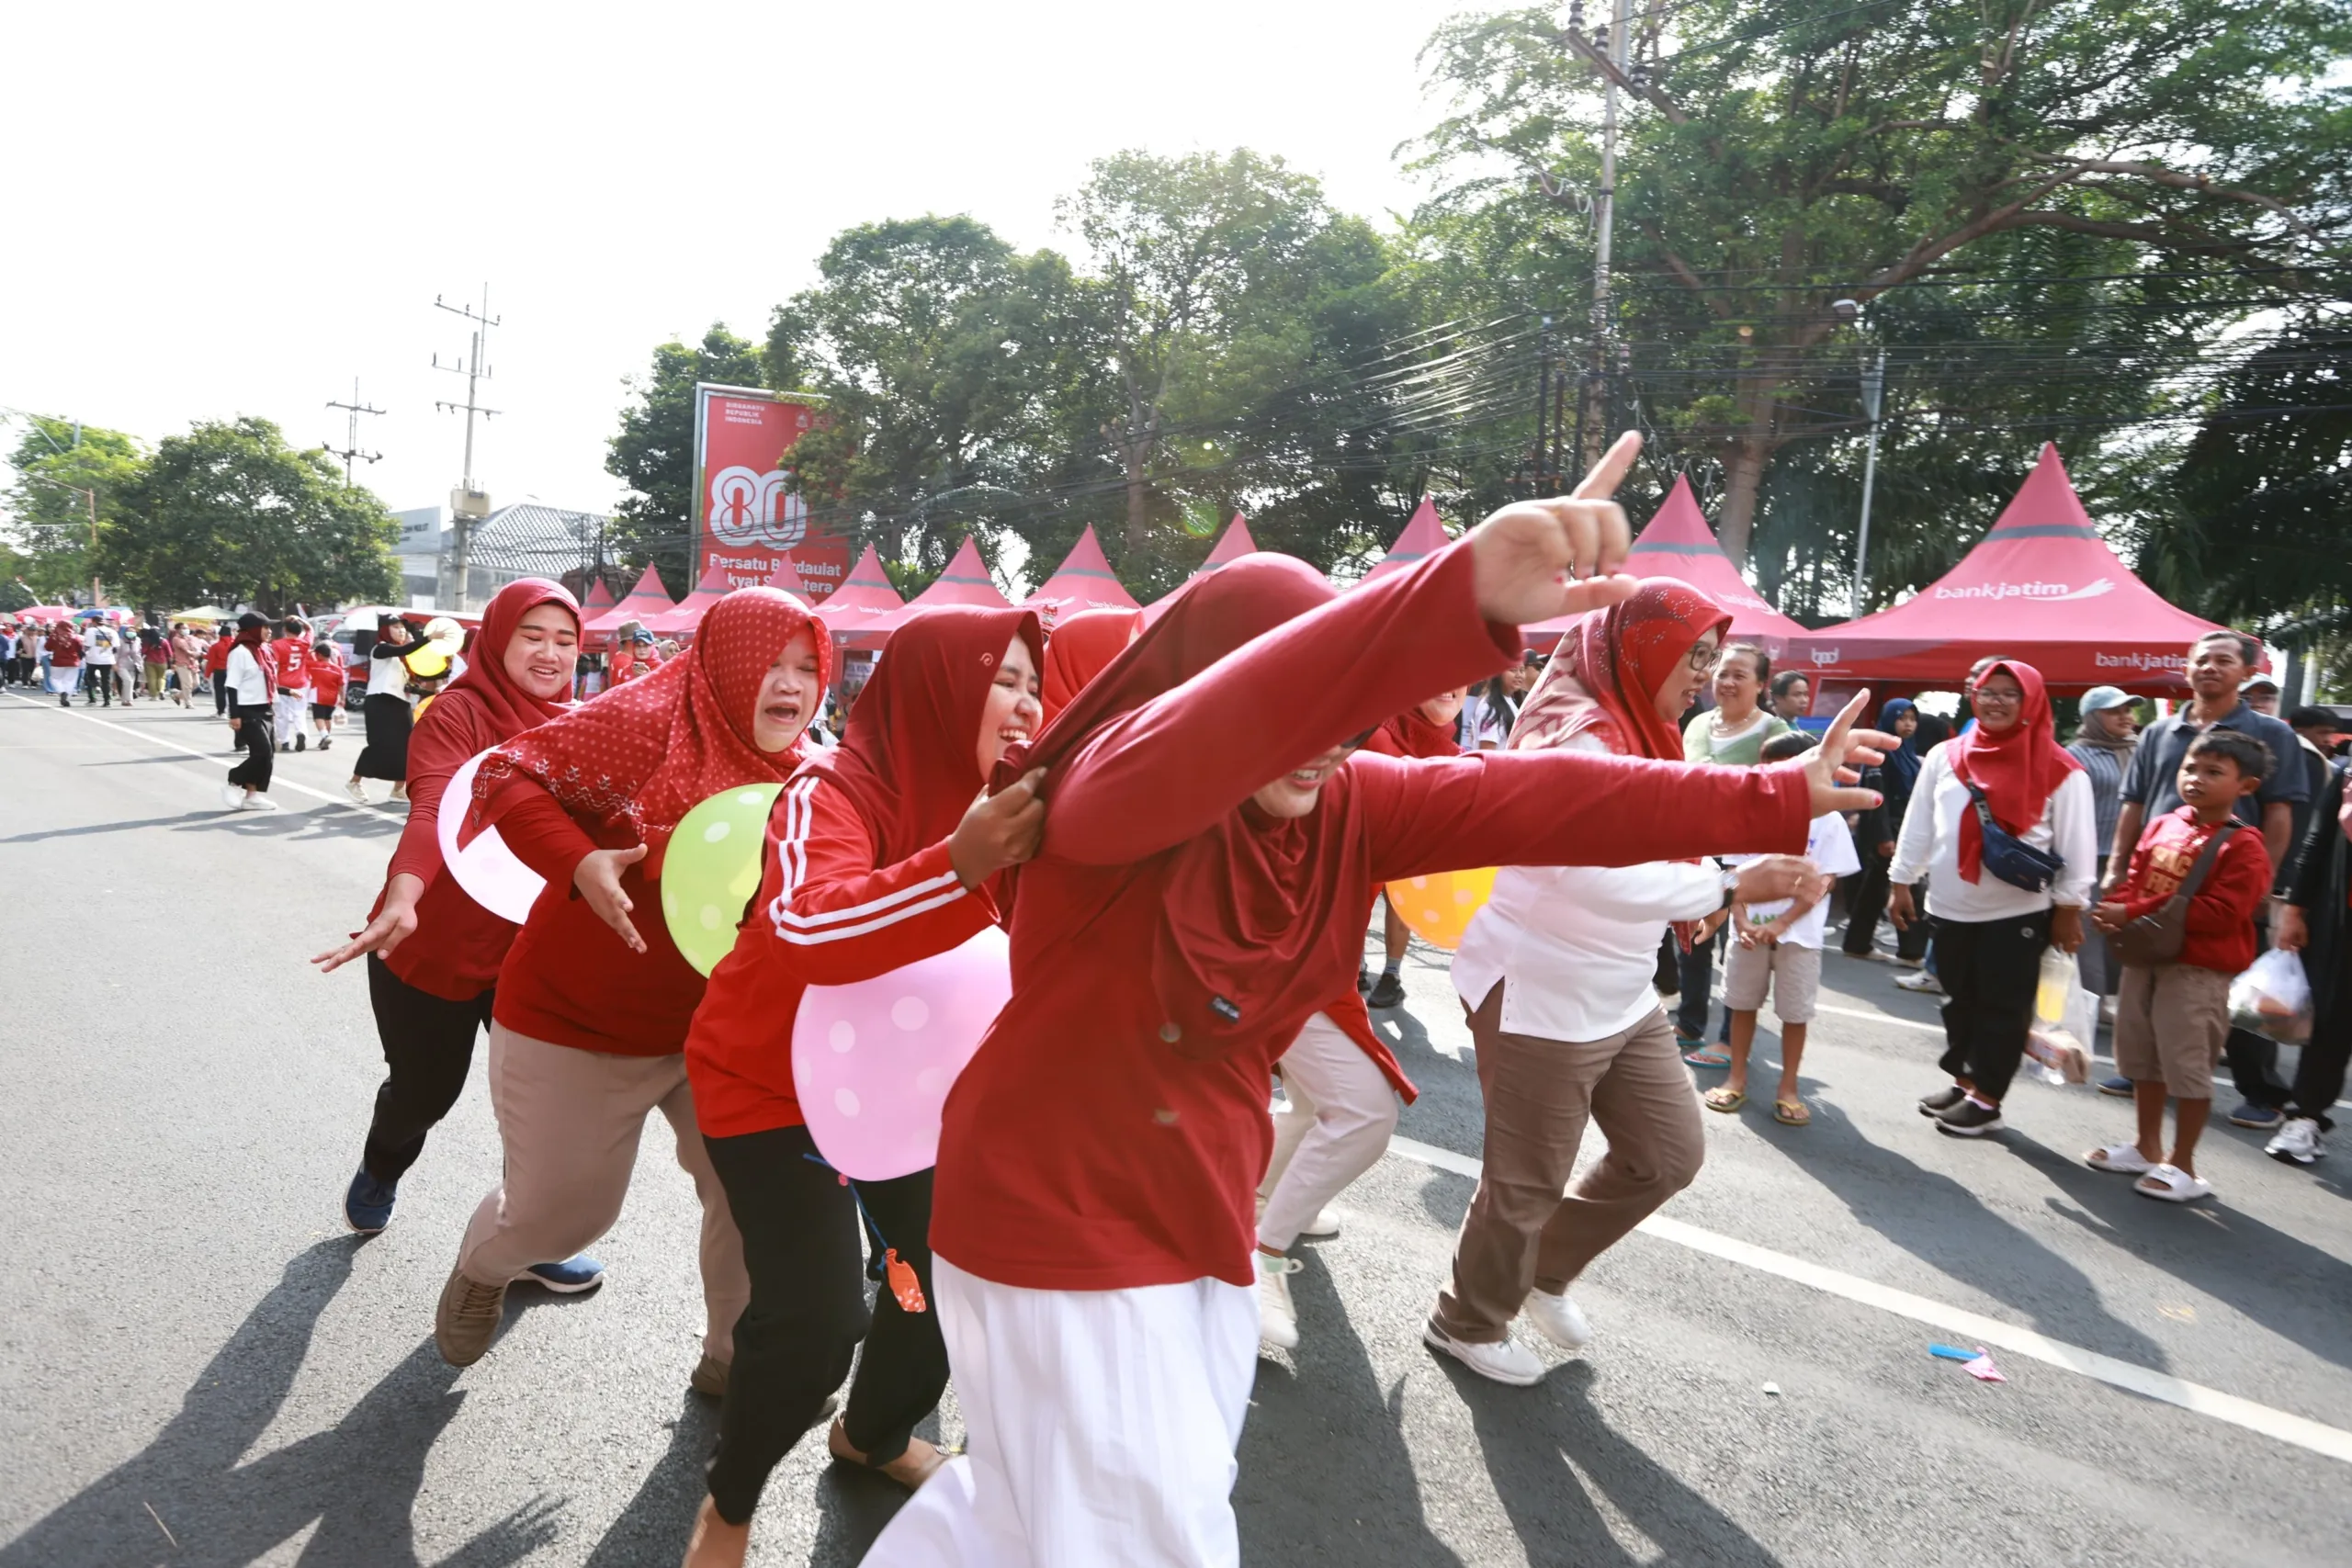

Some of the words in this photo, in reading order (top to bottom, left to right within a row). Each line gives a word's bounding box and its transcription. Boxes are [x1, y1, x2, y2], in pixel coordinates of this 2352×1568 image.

[724, 416, 763, 425] INDONESIA
[725, 409, 760, 418] REPUBLIK
[709, 466, 808, 551] 80
[1932, 581, 2069, 601] bankjatim
[288, 652, 302, 671] 5
